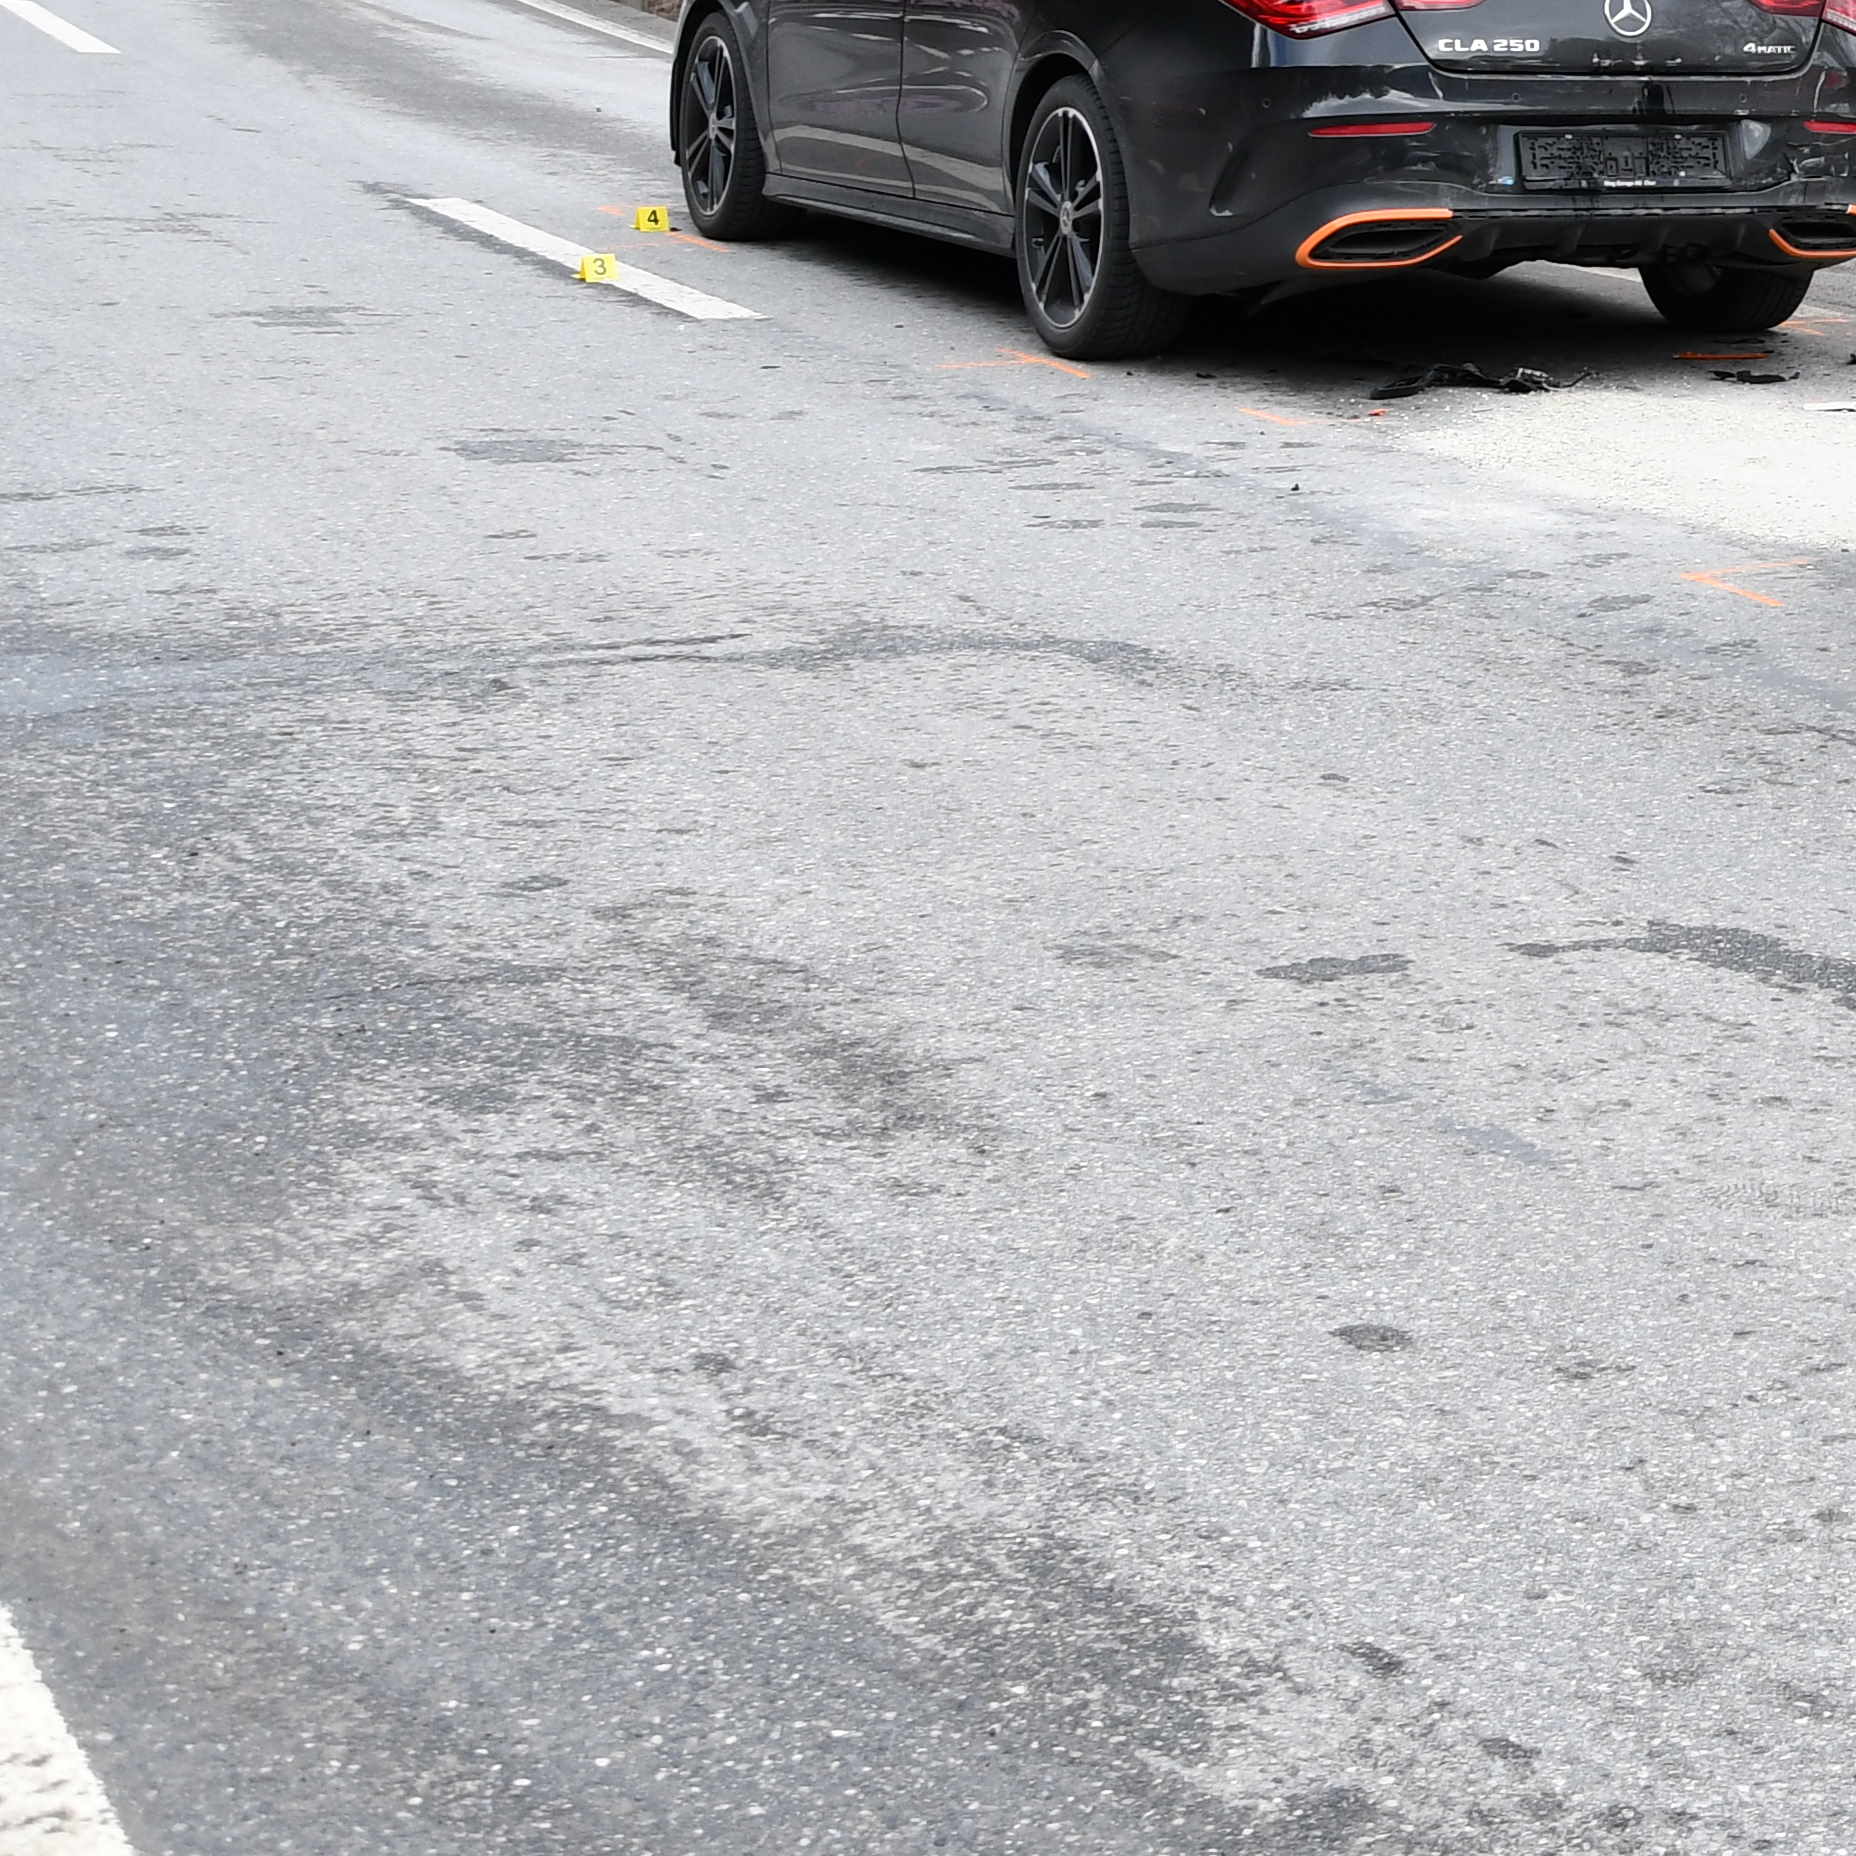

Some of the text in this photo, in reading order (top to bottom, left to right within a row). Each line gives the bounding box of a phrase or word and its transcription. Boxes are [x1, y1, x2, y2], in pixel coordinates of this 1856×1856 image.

[1438, 38, 1540, 52] CLA 250
[1743, 42, 1796, 55] 4MATIC
[647, 209, 660, 226] 4
[592, 257, 607, 276] 3
